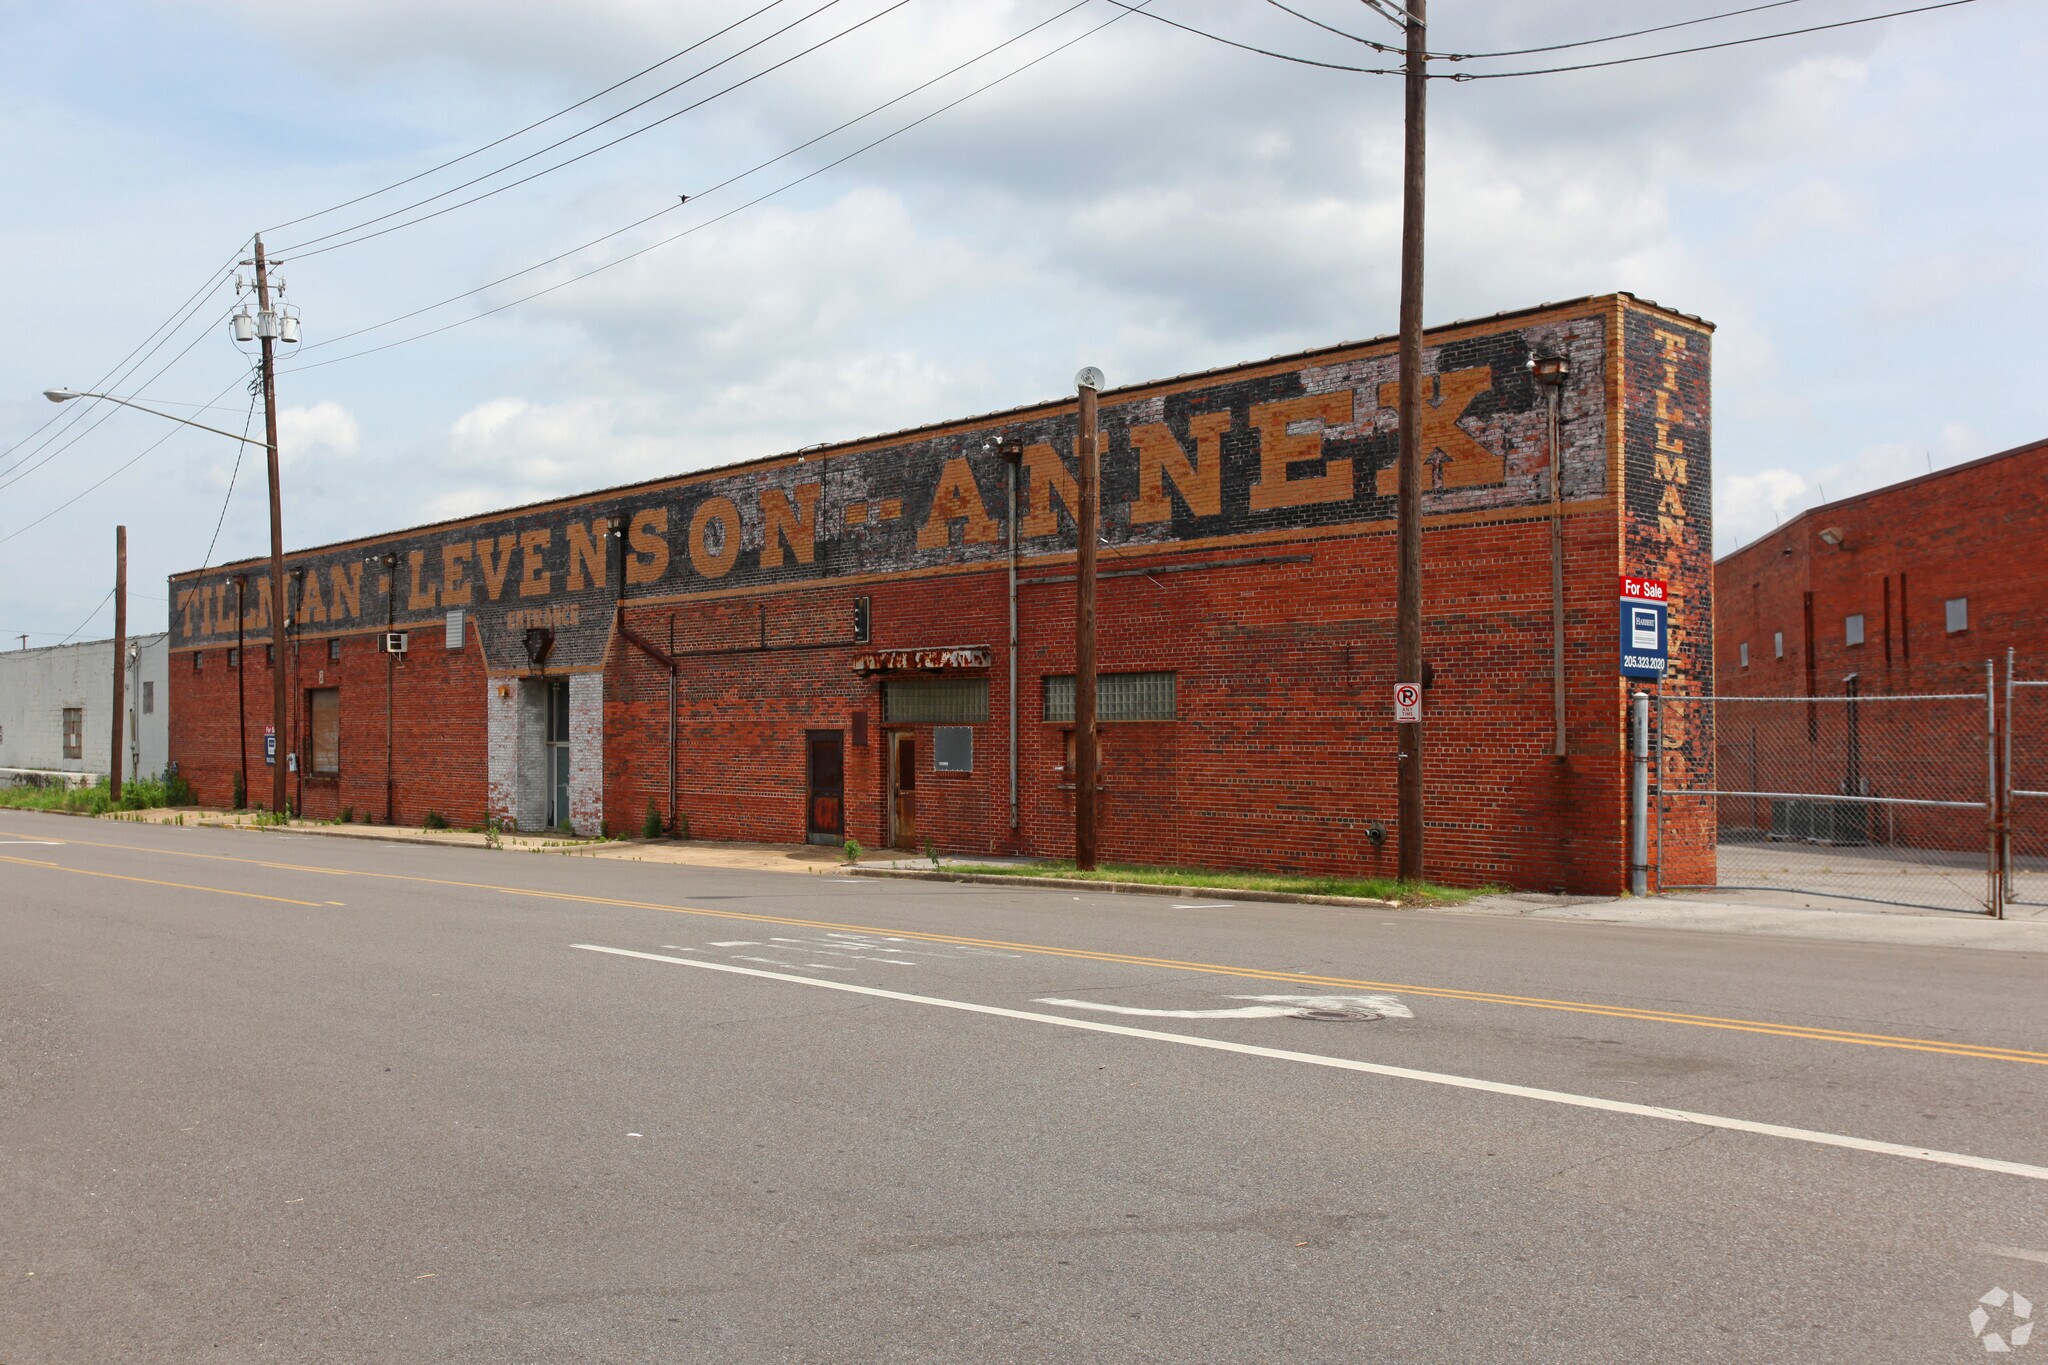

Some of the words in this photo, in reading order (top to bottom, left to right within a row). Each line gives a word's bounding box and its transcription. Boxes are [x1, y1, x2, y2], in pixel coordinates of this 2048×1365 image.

[408, 484, 821, 611] LEVENSON
[917, 366, 1505, 550] ANNEX
[1654, 328, 1688, 546] TILLMAN
[1625, 579, 1641, 596] For
[1643, 581, 1663, 599] Sale
[1624, 656, 1665, 670] 205.323.2020
